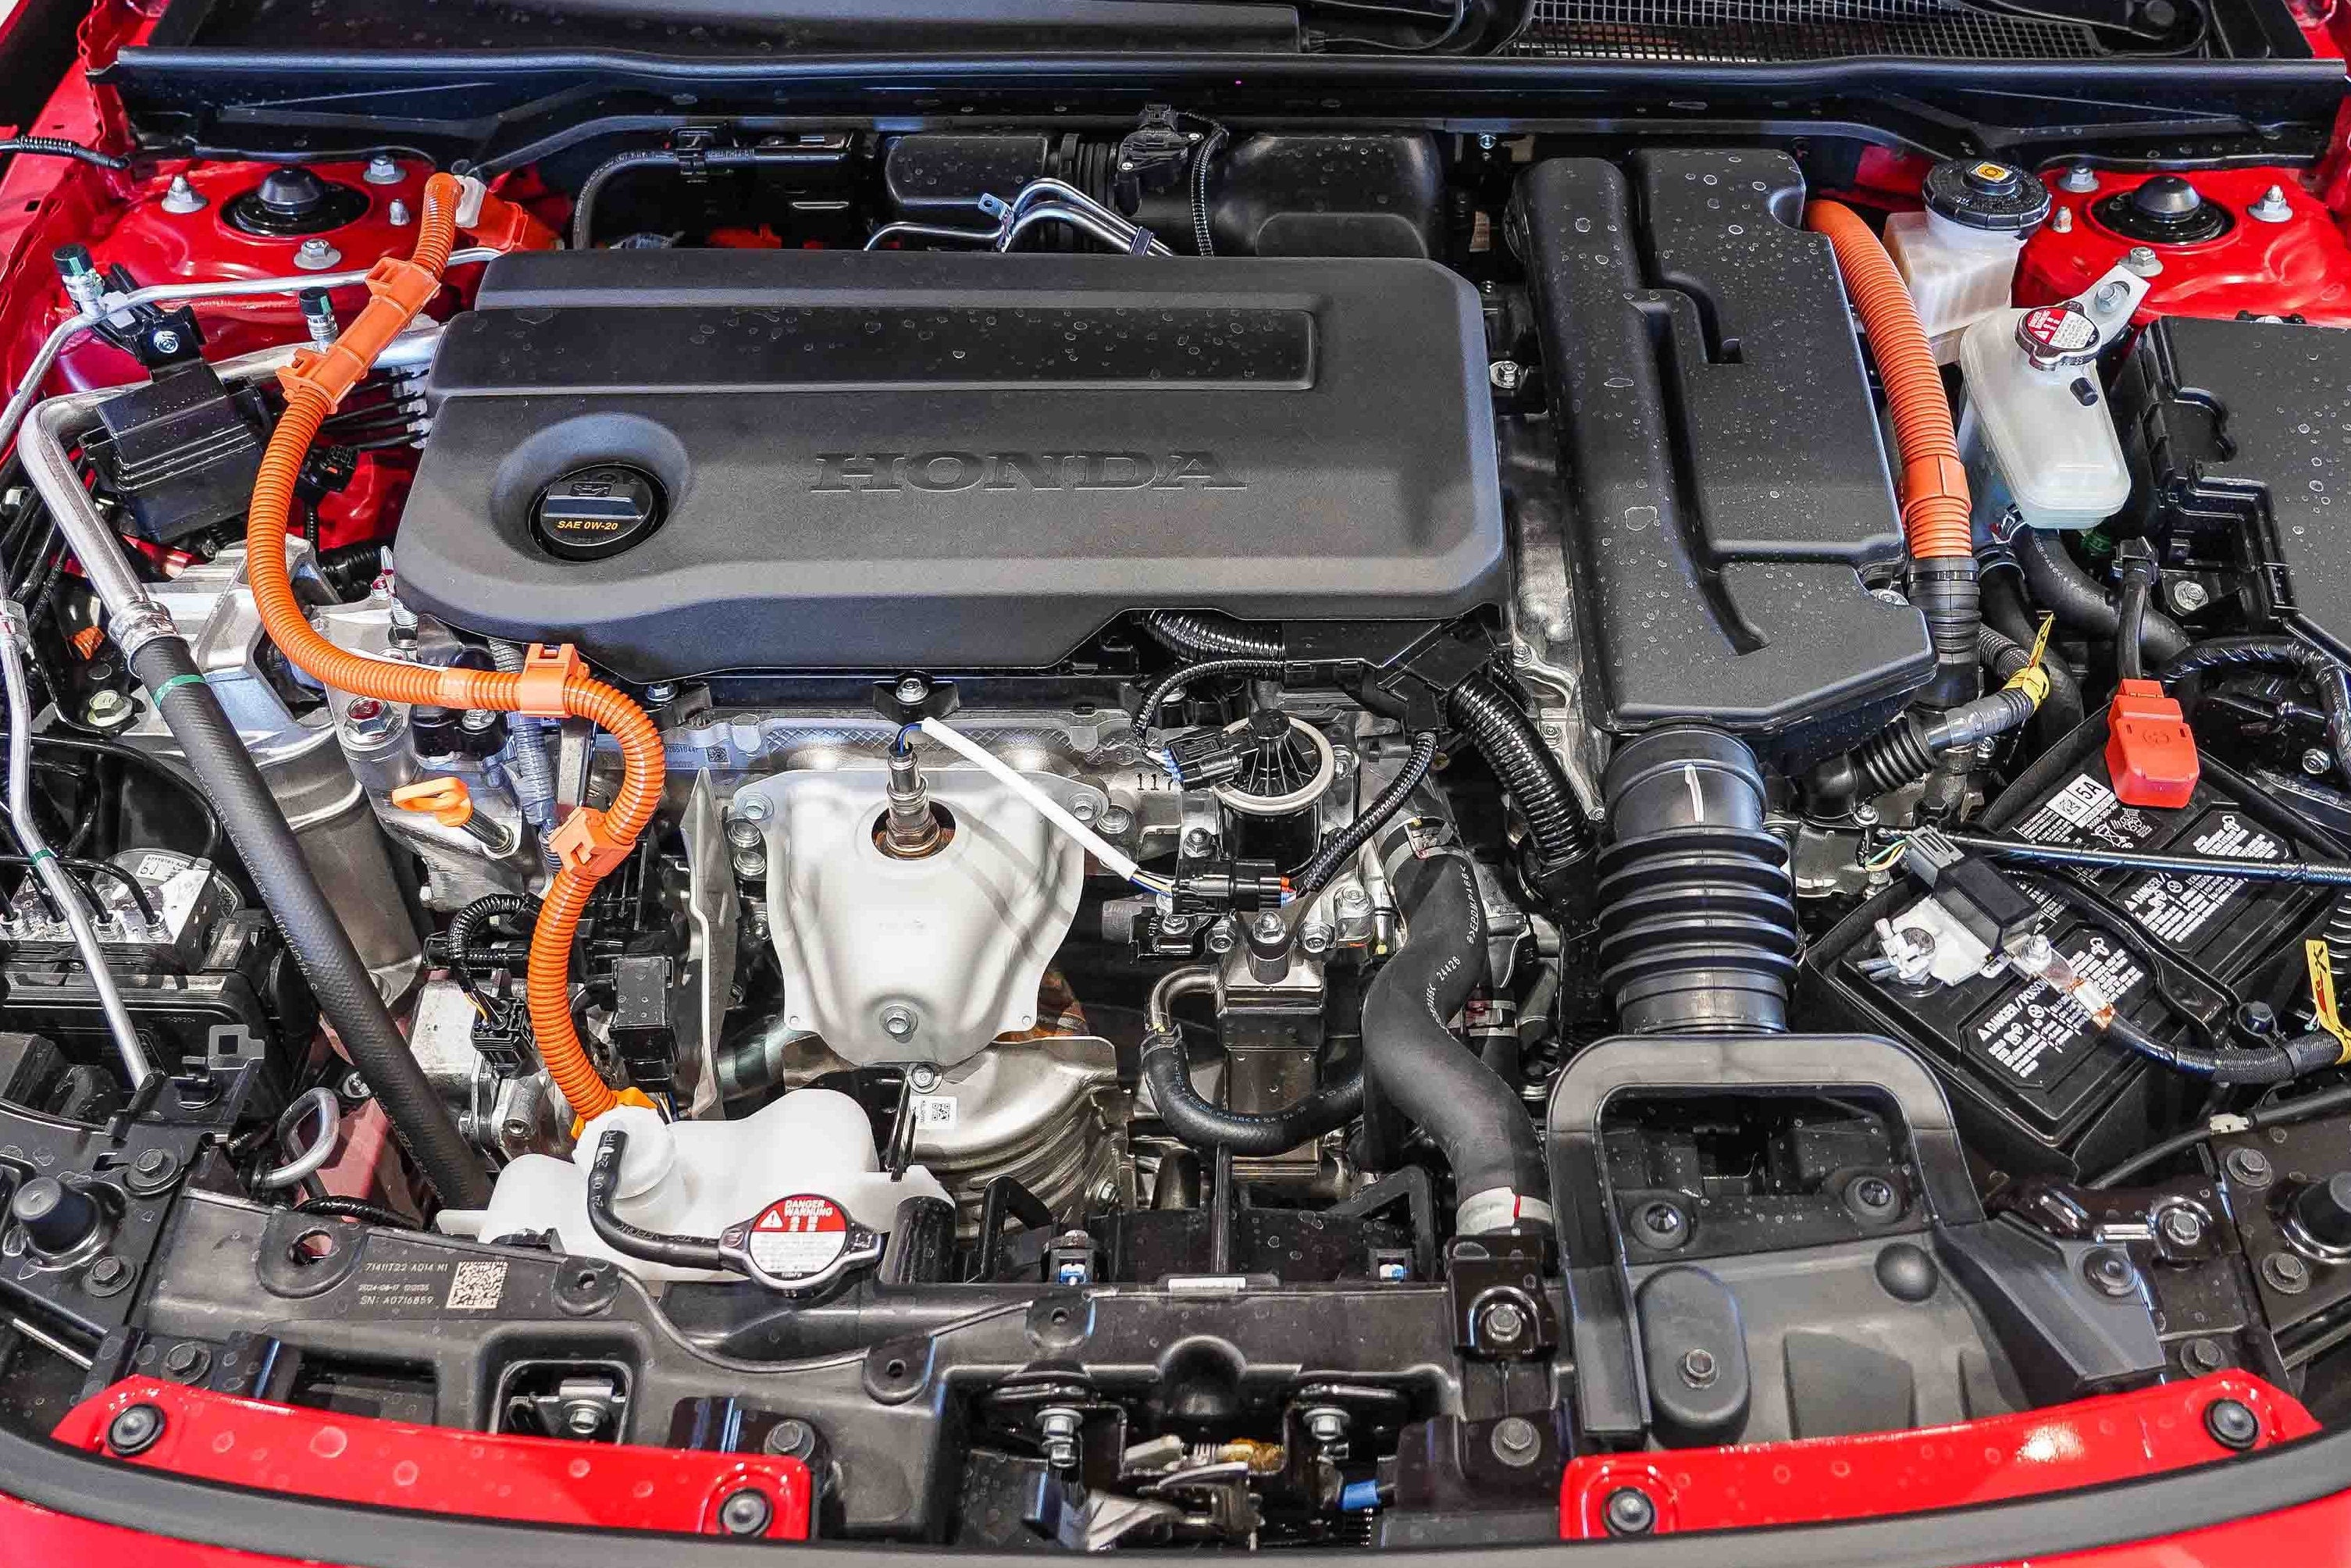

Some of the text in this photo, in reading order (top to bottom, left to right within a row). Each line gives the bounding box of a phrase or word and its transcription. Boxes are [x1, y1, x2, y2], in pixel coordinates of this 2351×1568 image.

[810, 451, 1248, 494] HONDA
[557, 520, 618, 530] SAE 0W-20
[2075, 780, 2102, 800] 5A
[1435, 956, 1462, 982] 24426
[785, 1199, 825, 1209] DANGER
[359, 1295, 380, 1305] SN:
